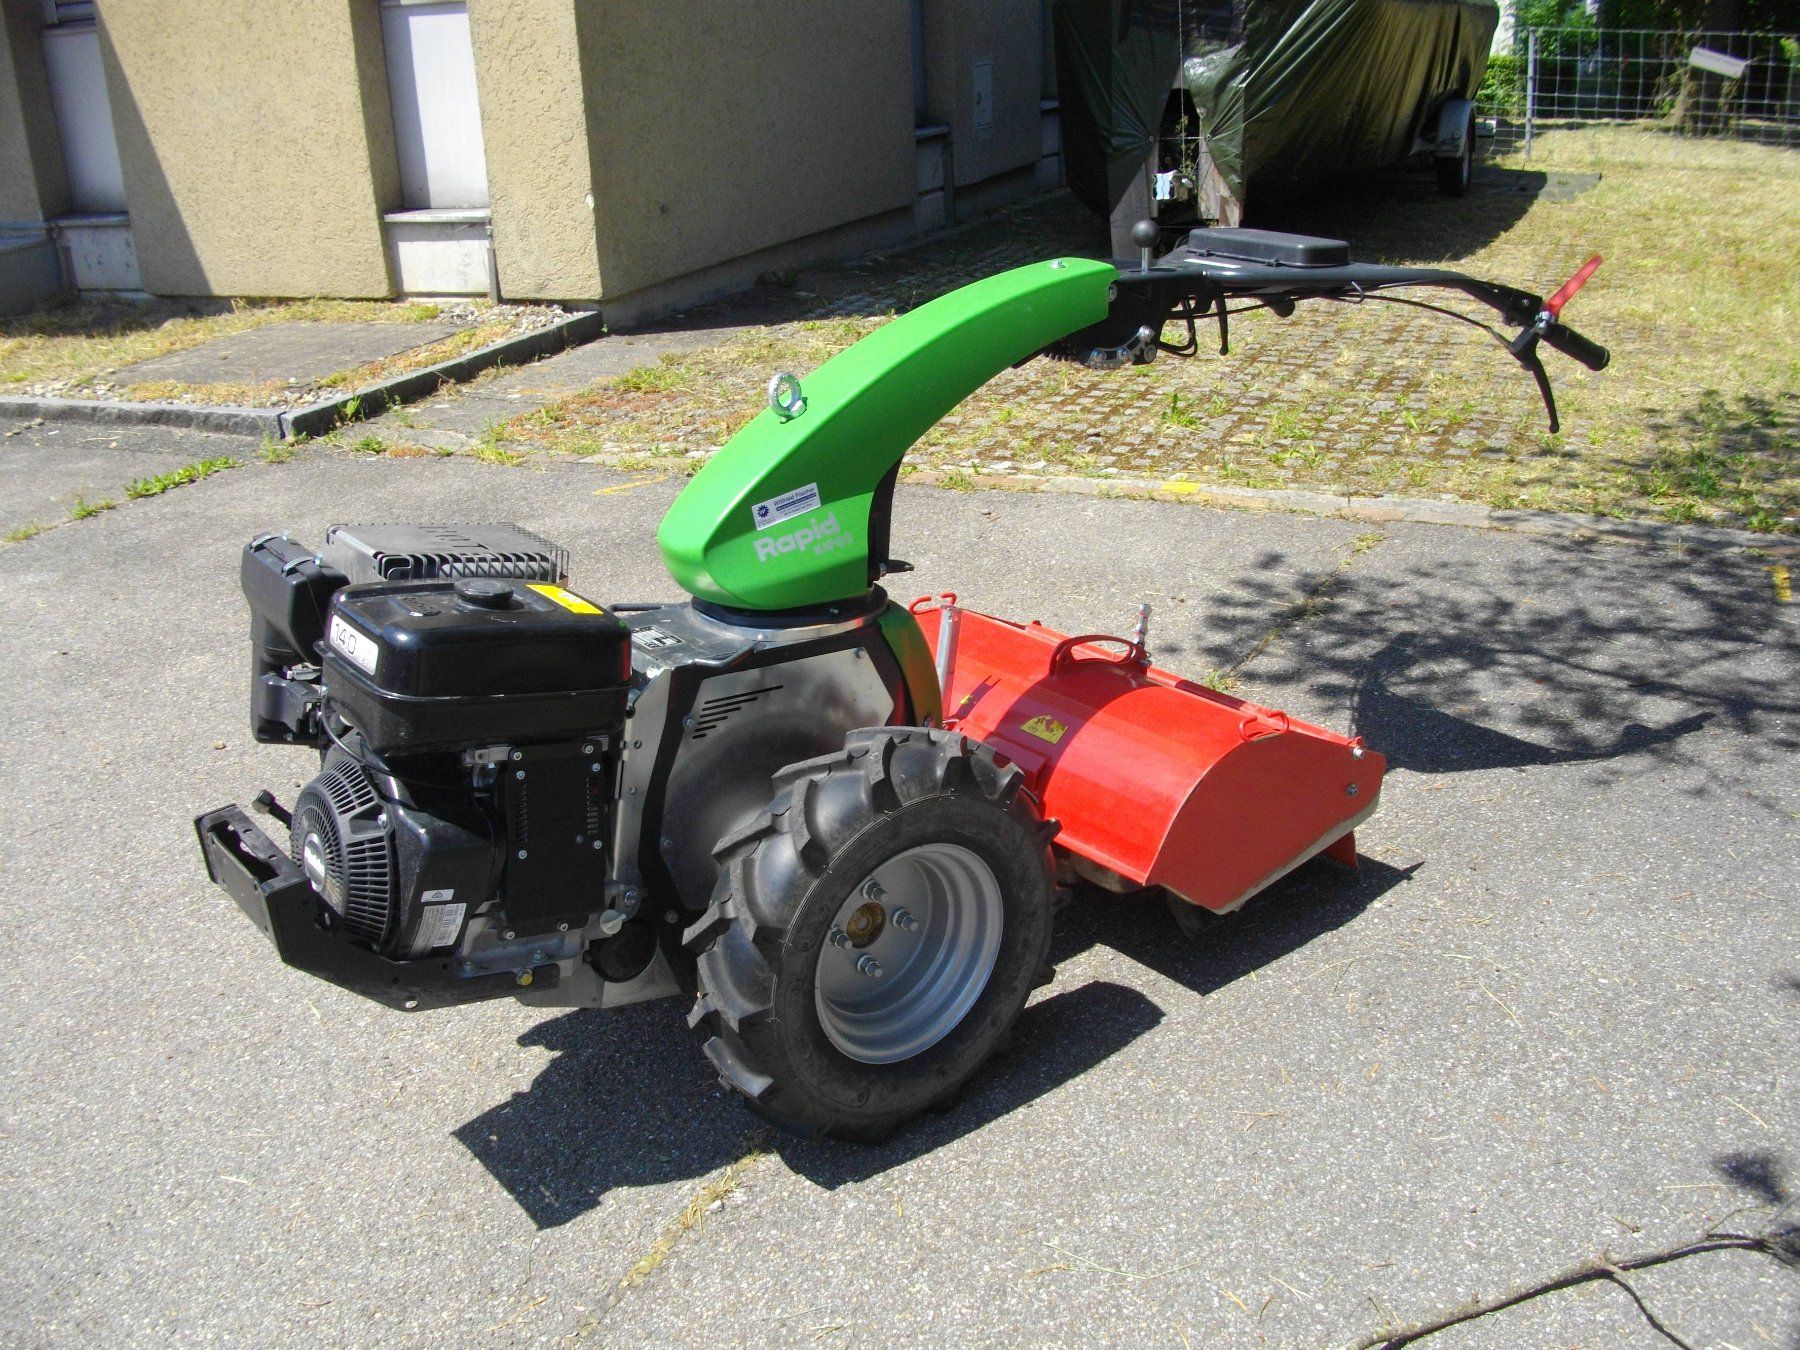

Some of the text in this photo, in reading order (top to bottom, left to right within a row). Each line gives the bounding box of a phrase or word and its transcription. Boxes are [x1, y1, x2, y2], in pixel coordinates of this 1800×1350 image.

[773, 494, 795, 506] Wilfried
[795, 487, 815, 498] Fischer
[753, 511, 840, 562] Rapid
